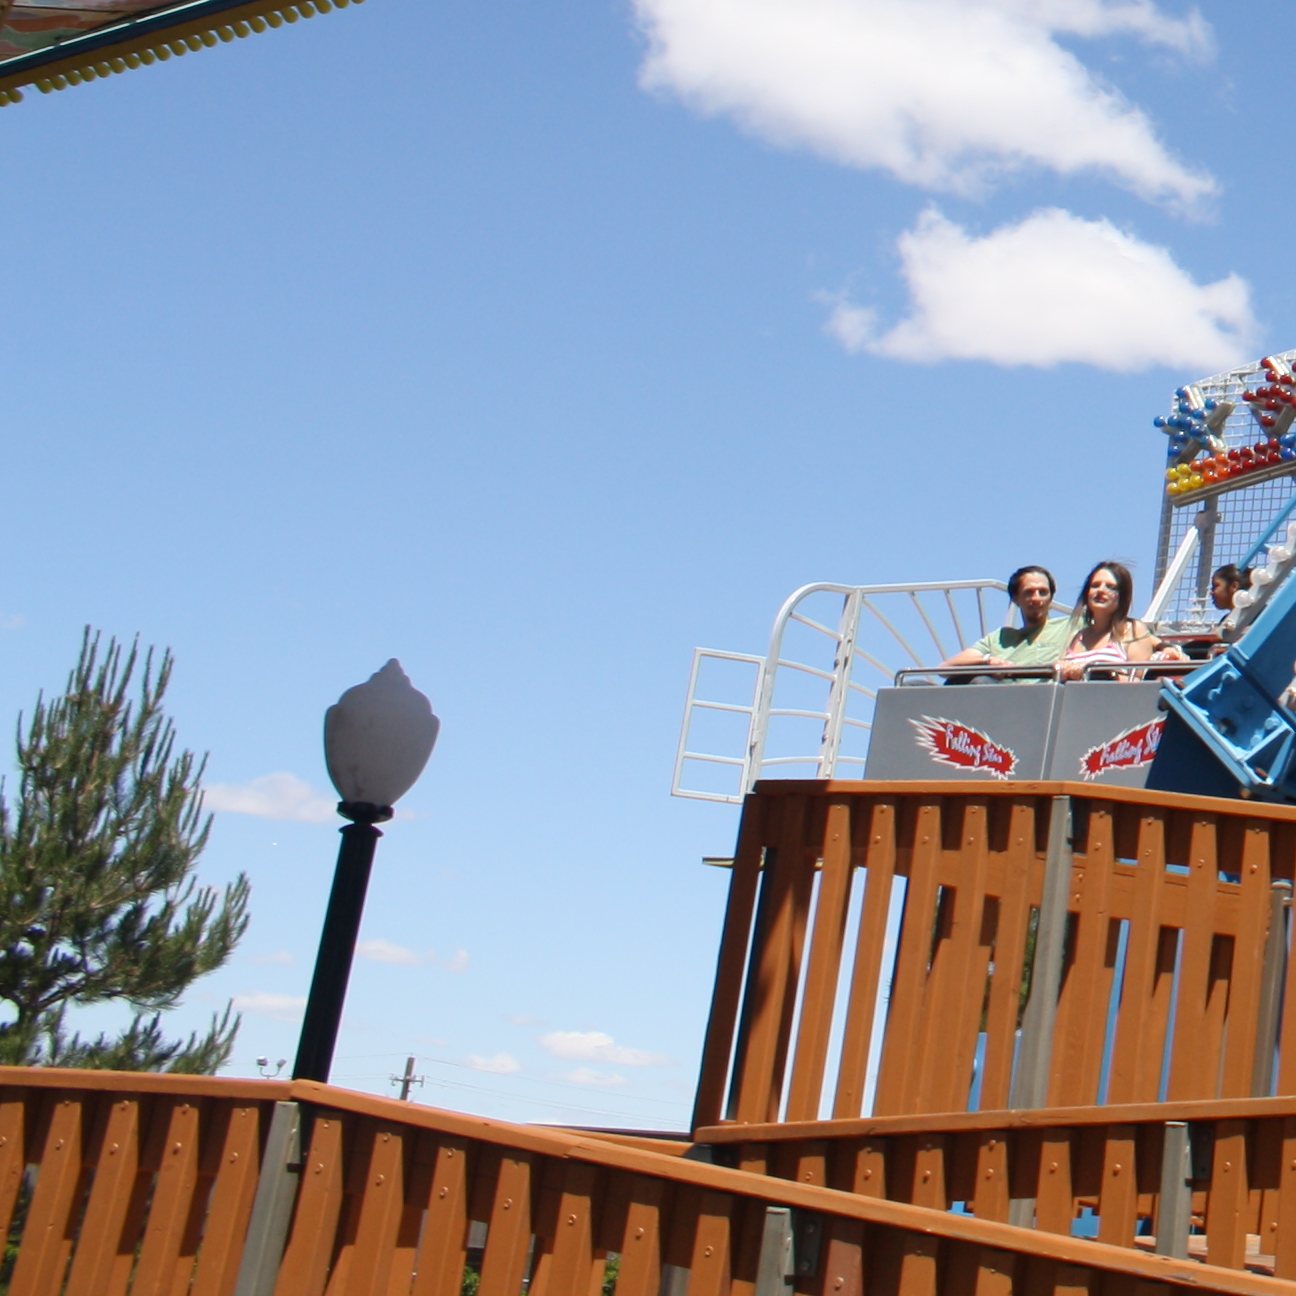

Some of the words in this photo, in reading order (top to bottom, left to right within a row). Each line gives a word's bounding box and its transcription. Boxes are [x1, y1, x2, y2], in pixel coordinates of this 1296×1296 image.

[945, 723, 981, 767] Falling
[982, 742, 1002, 764] Star
[1099, 739, 1144, 766] Falling
